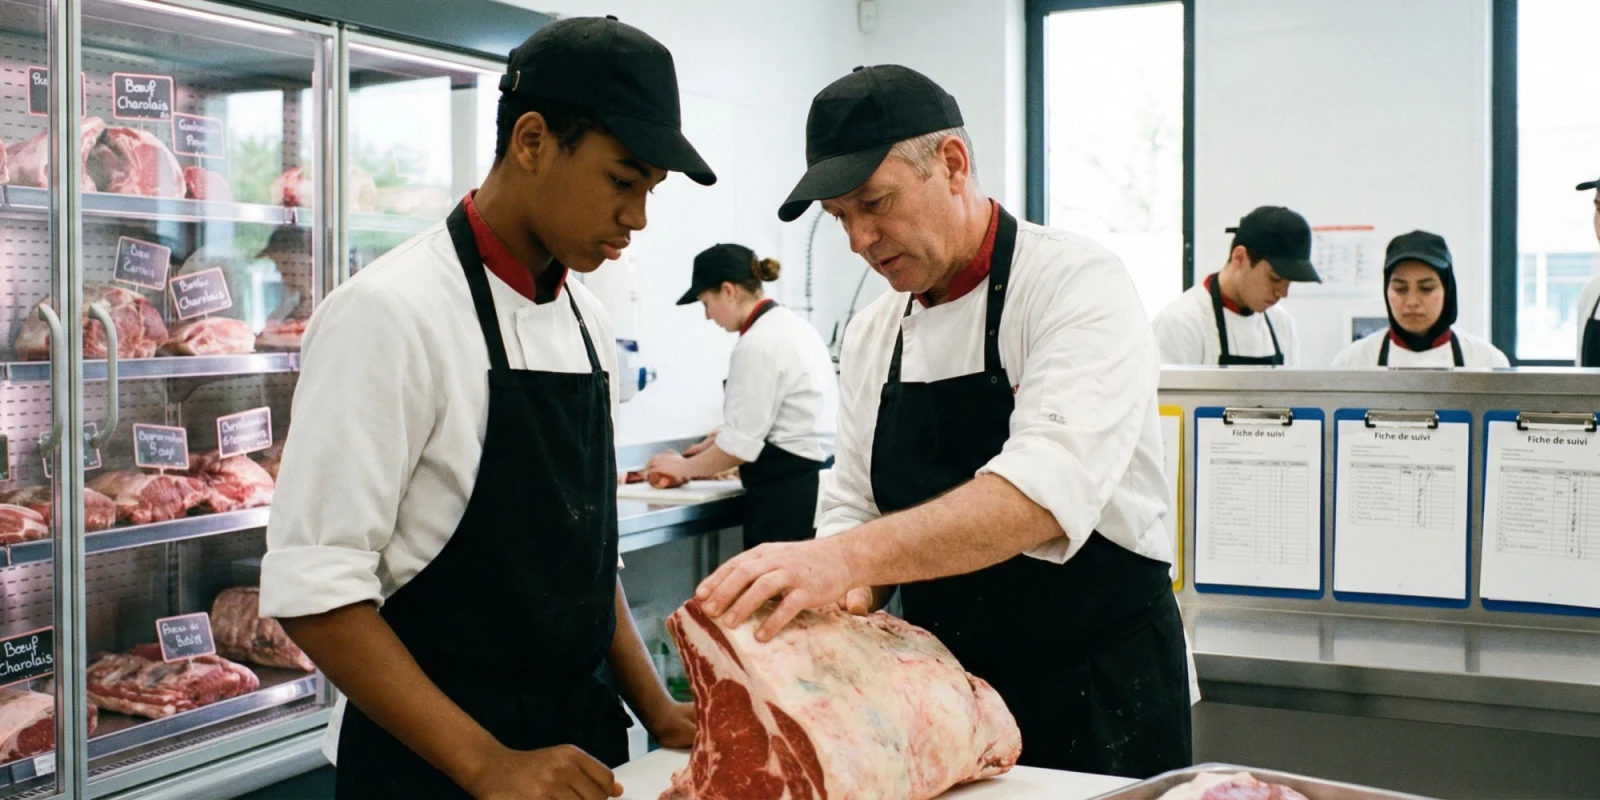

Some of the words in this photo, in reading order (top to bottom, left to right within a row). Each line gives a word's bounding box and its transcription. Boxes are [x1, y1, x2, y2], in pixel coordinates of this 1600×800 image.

[117, 96, 169, 111] Charolais
[1232, 429, 1252, 437] Fiche
[1254, 429, 1265, 437] de
[1266, 430, 1285, 438] suivi
[1374, 431, 1396, 440] Fiche
[1398, 432, 1409, 440] de
[1411, 433, 1430, 441] suivi
[1527, 435, 1550, 444] Fiche
[1552, 436, 1564, 445] de
[1566, 437, 1588, 446] suivi
[4, 635, 39, 658] Bœuf
[0, 652, 53, 676] Charolais
